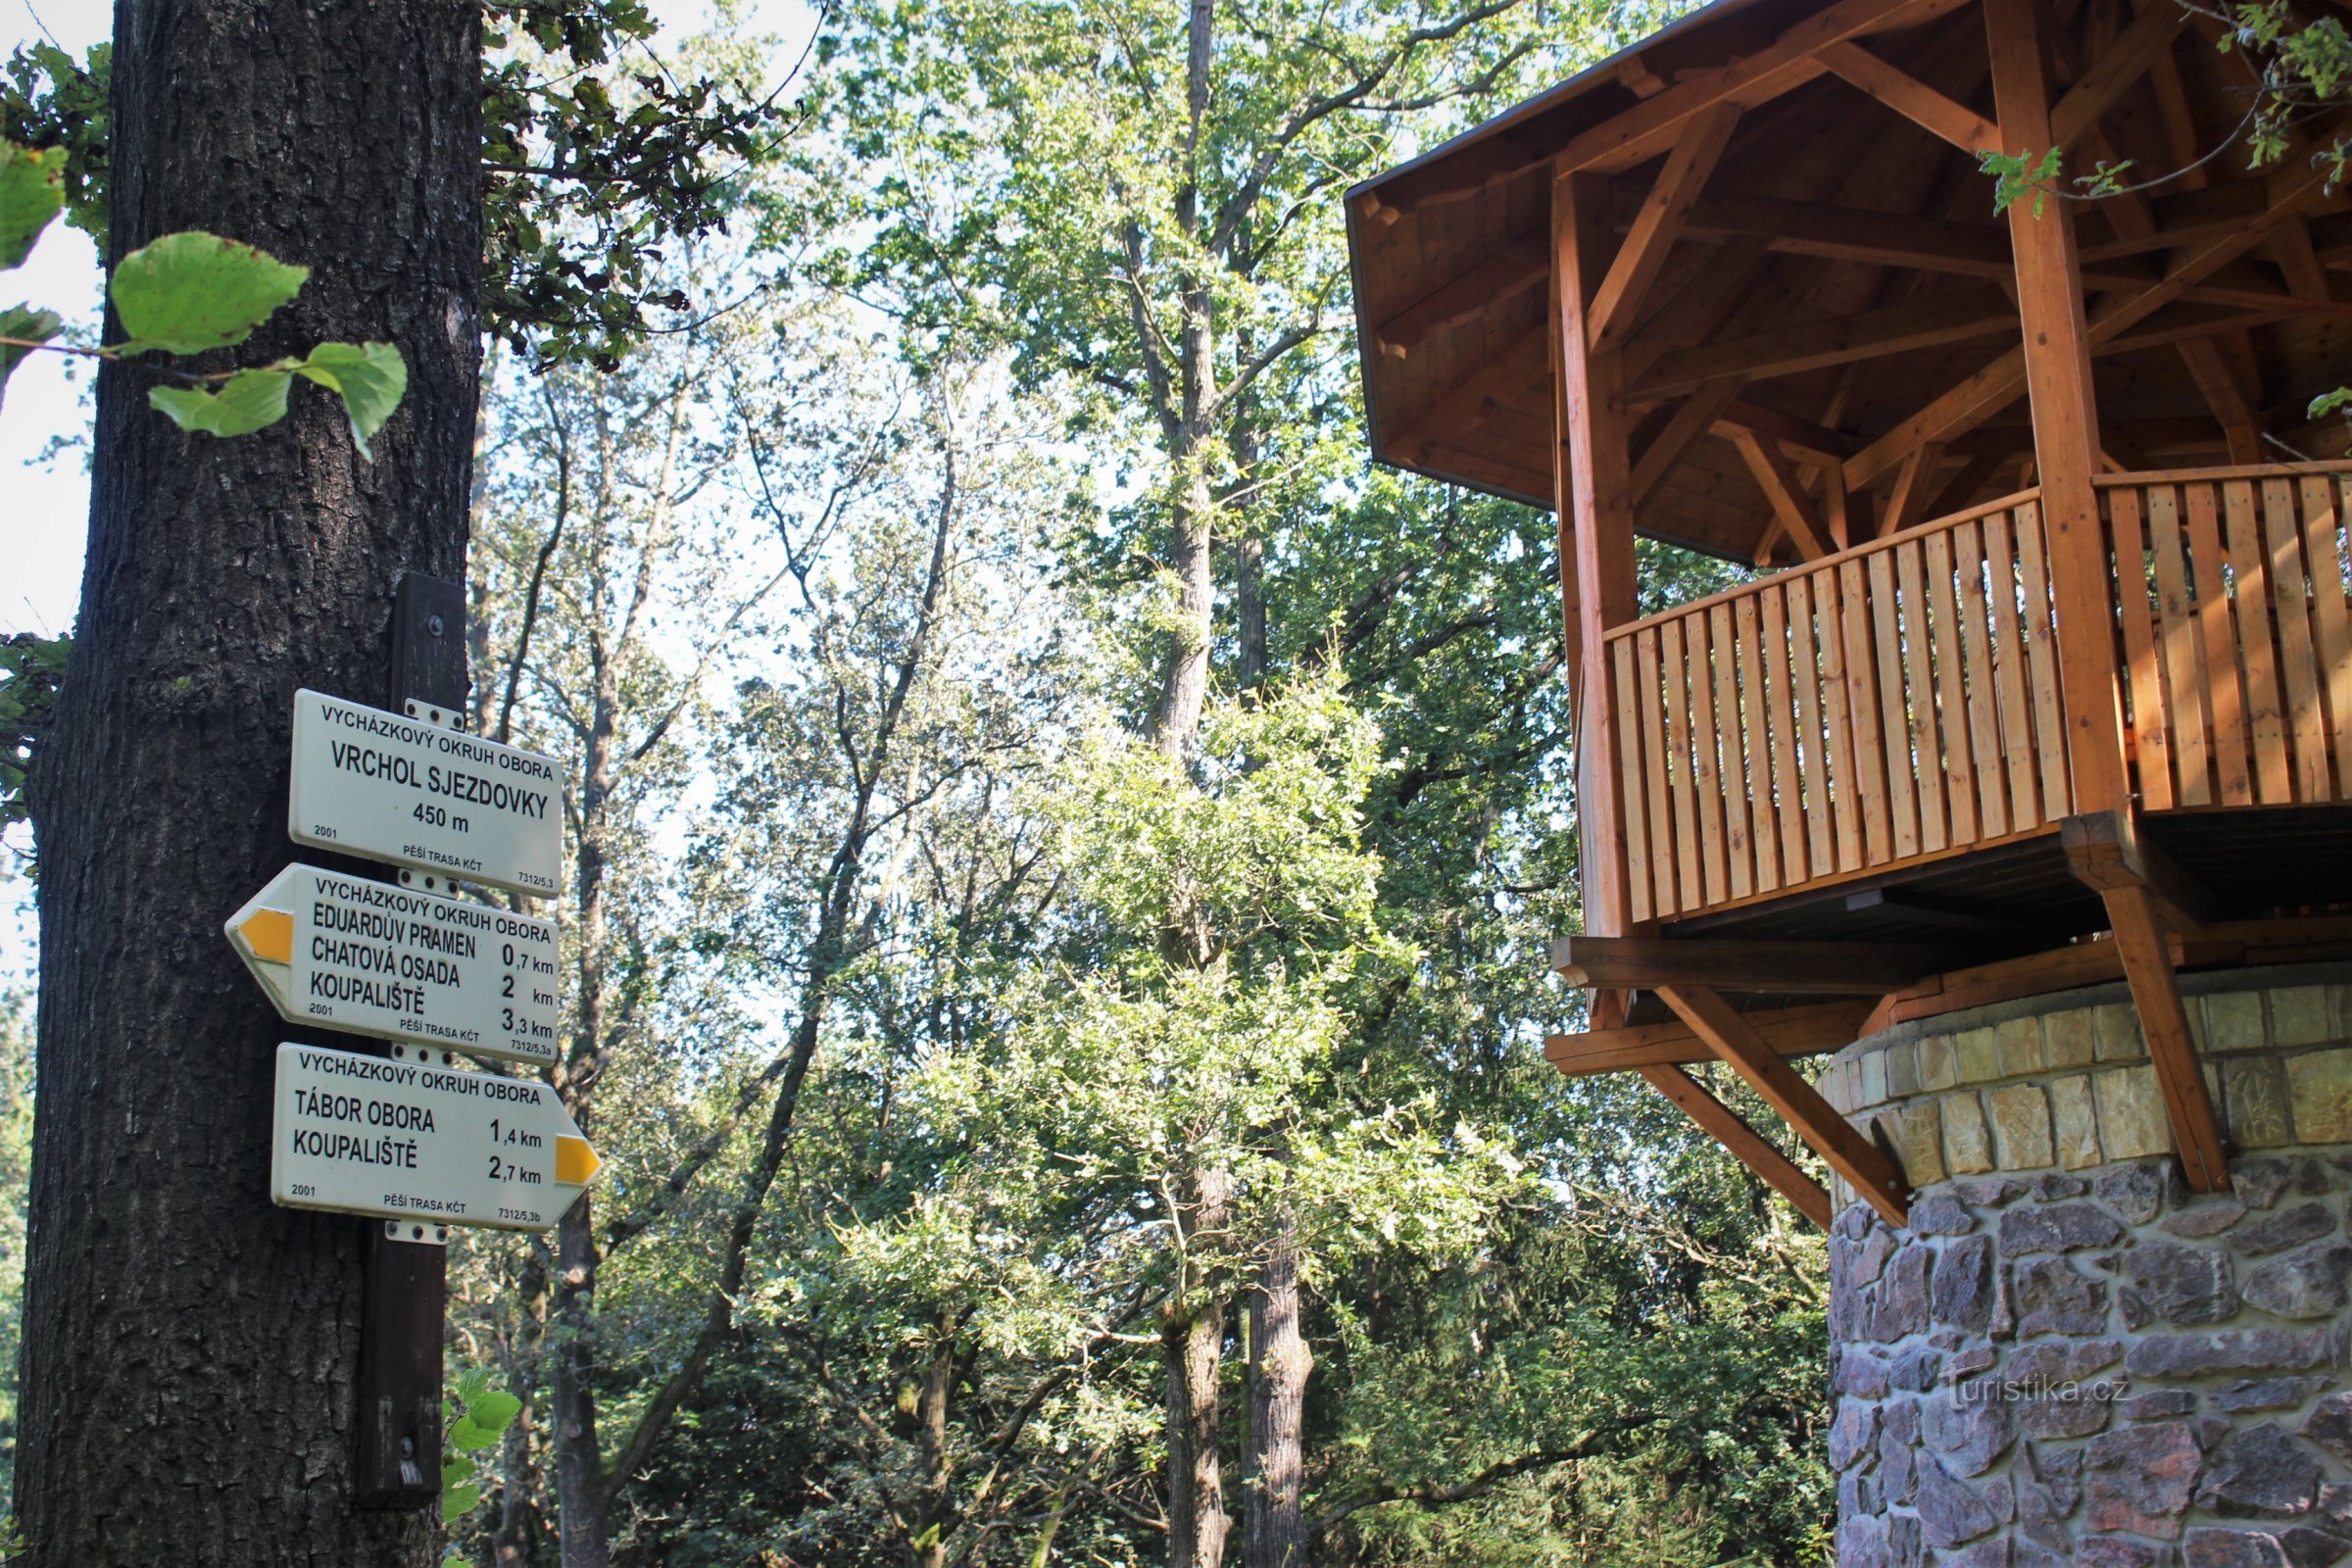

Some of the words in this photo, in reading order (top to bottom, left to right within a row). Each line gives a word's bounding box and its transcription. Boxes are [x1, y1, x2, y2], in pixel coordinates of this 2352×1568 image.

[321, 705, 434, 748] VYCHÁZKOVÝ
[439, 737, 494, 765] OKRUH
[499, 753, 553, 781] OBORA
[331, 740, 421, 789] VRCHOL
[427, 765, 548, 819] SJEZDOVKY
[315, 825, 337, 839] 2001
[414, 803, 446, 827] 450
[453, 813, 468, 833] m
[403, 845, 425, 859] PĚŠÍ
[428, 851, 461, 869] TRASA
[463, 859, 482, 872] KČT
[316, 877, 429, 917] VYCHÁZKOVÝ
[434, 905, 491, 931] OKRUH
[496, 918, 551, 944] OBORA
[314, 902, 406, 944] EDUARDŮV
[410, 922, 476, 959] PRAMEN
[502, 944, 528, 970] 0,7
[533, 956, 554, 975] km
[312, 937, 396, 976] CHATOVÁ
[401, 955, 461, 988] OSADA
[502, 975, 514, 999] 2
[533, 989, 553, 1006] km
[310, 1003, 333, 1016] 2001
[311, 971, 424, 1014] KOUPALIŠTĚ
[502, 1007, 527, 1035] 3,3
[531, 1020, 553, 1039] km
[424, 1023, 458, 1039] TRASA
[460, 1029, 480, 1043] KČT
[300, 1053, 416, 1087] VYCHÁZKOVÝ
[422, 1072, 479, 1097] OKRUH
[484, 1082, 541, 1105] OBORA
[295, 1087, 362, 1123] TÁBOR
[368, 1101, 435, 1133] OBORA
[490, 1119, 516, 1147] 1,4
[520, 1130, 542, 1149] km
[294, 1129, 417, 1169] KOUPALIŠTĚ
[488, 1155, 515, 1183] 2,7
[519, 1166, 541, 1185] km
[292, 1184, 316, 1198] 2001
[384, 1194, 408, 1208] PĚŠÍ
[410, 1198, 443, 1212] TRASA
[446, 1200, 466, 1214] KČT
